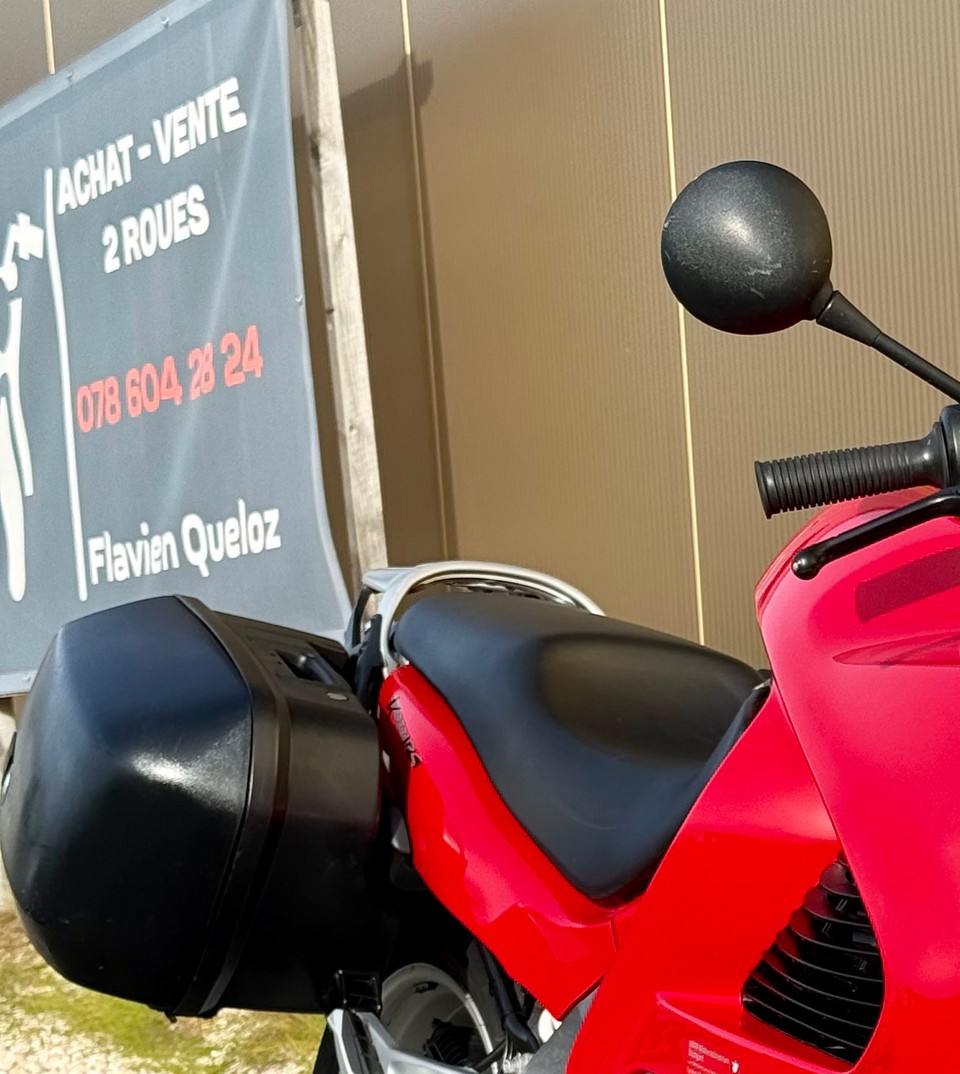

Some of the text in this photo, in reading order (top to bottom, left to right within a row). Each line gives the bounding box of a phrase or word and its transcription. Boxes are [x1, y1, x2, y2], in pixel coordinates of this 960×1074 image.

[57, 134, 134, 215] ACHAT
[152, 76, 248, 165] VENTE
[102, 184, 210, 274] 2 ROUES
[76, 325, 263, 433] 078 604 28 24
[87, 498, 282, 585] Flavien Queloz
